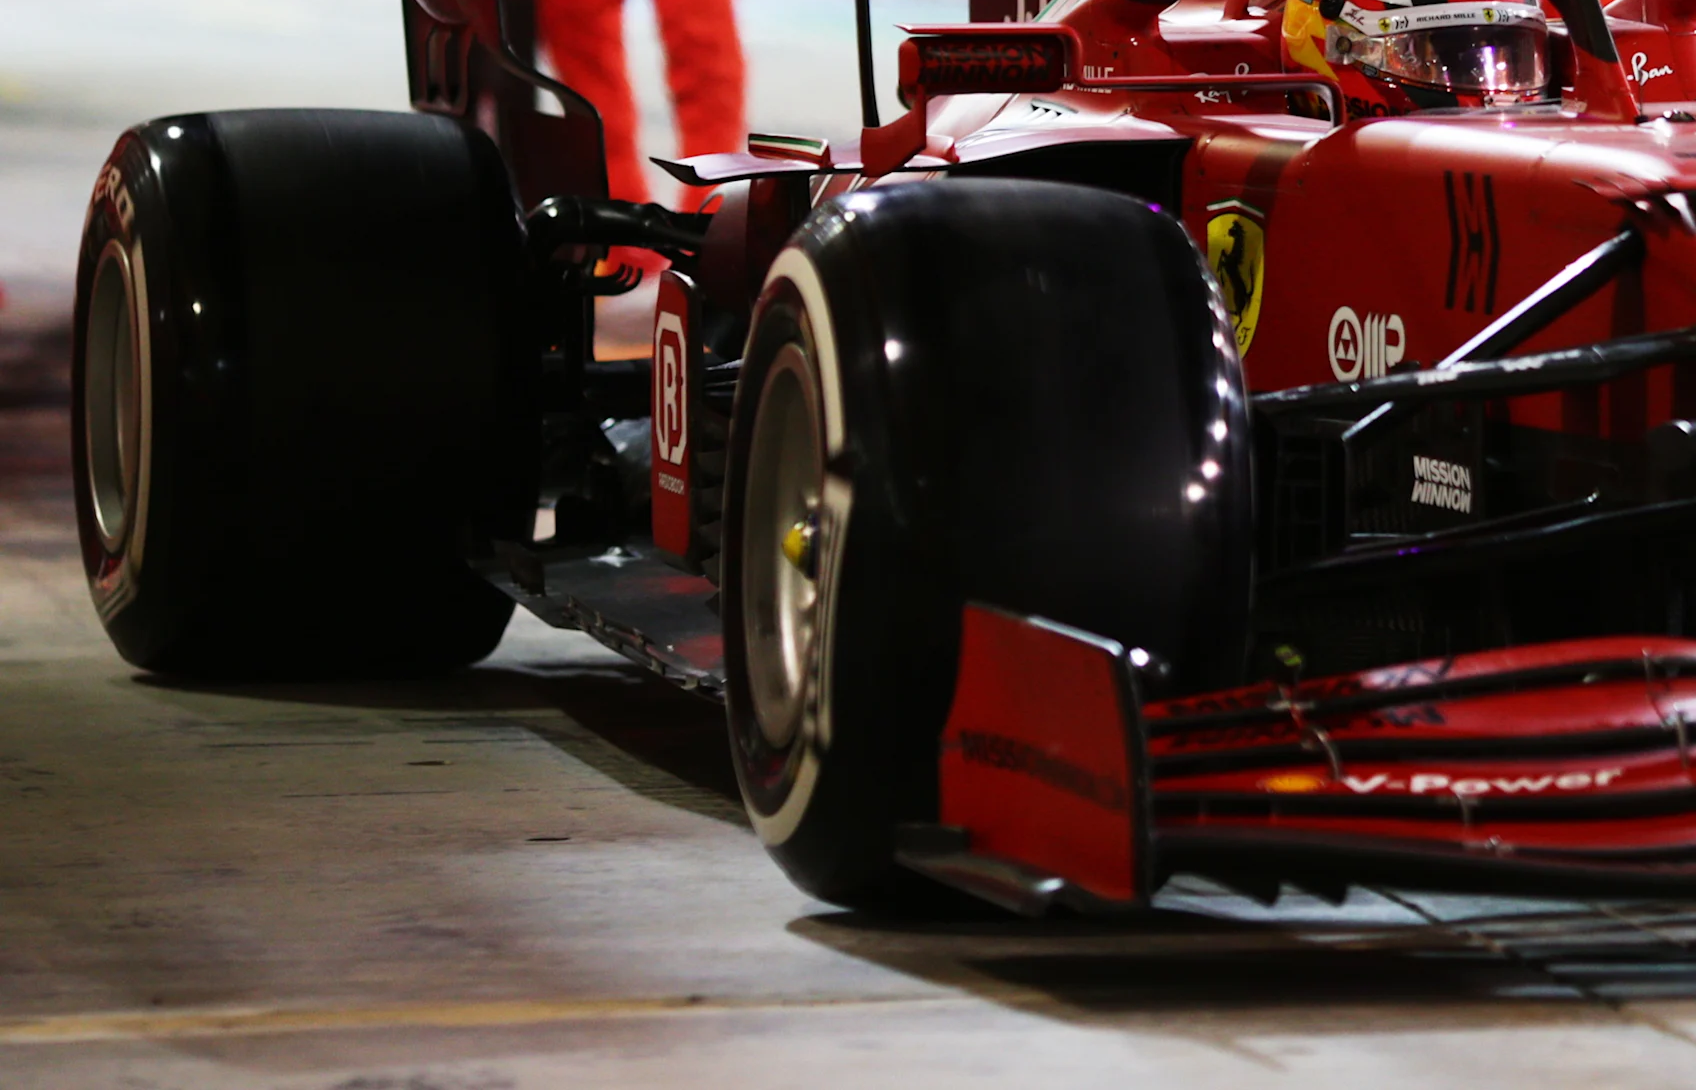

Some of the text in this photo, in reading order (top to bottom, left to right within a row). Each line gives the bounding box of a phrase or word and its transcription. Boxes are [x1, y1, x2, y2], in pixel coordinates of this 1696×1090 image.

[1416, 12, 1475, 22] RICHARD MILLE
[1412, 454, 1472, 491] MISSION
[1410, 480, 1472, 514] WINNOW
[1342, 766, 1624, 796] V-Power
